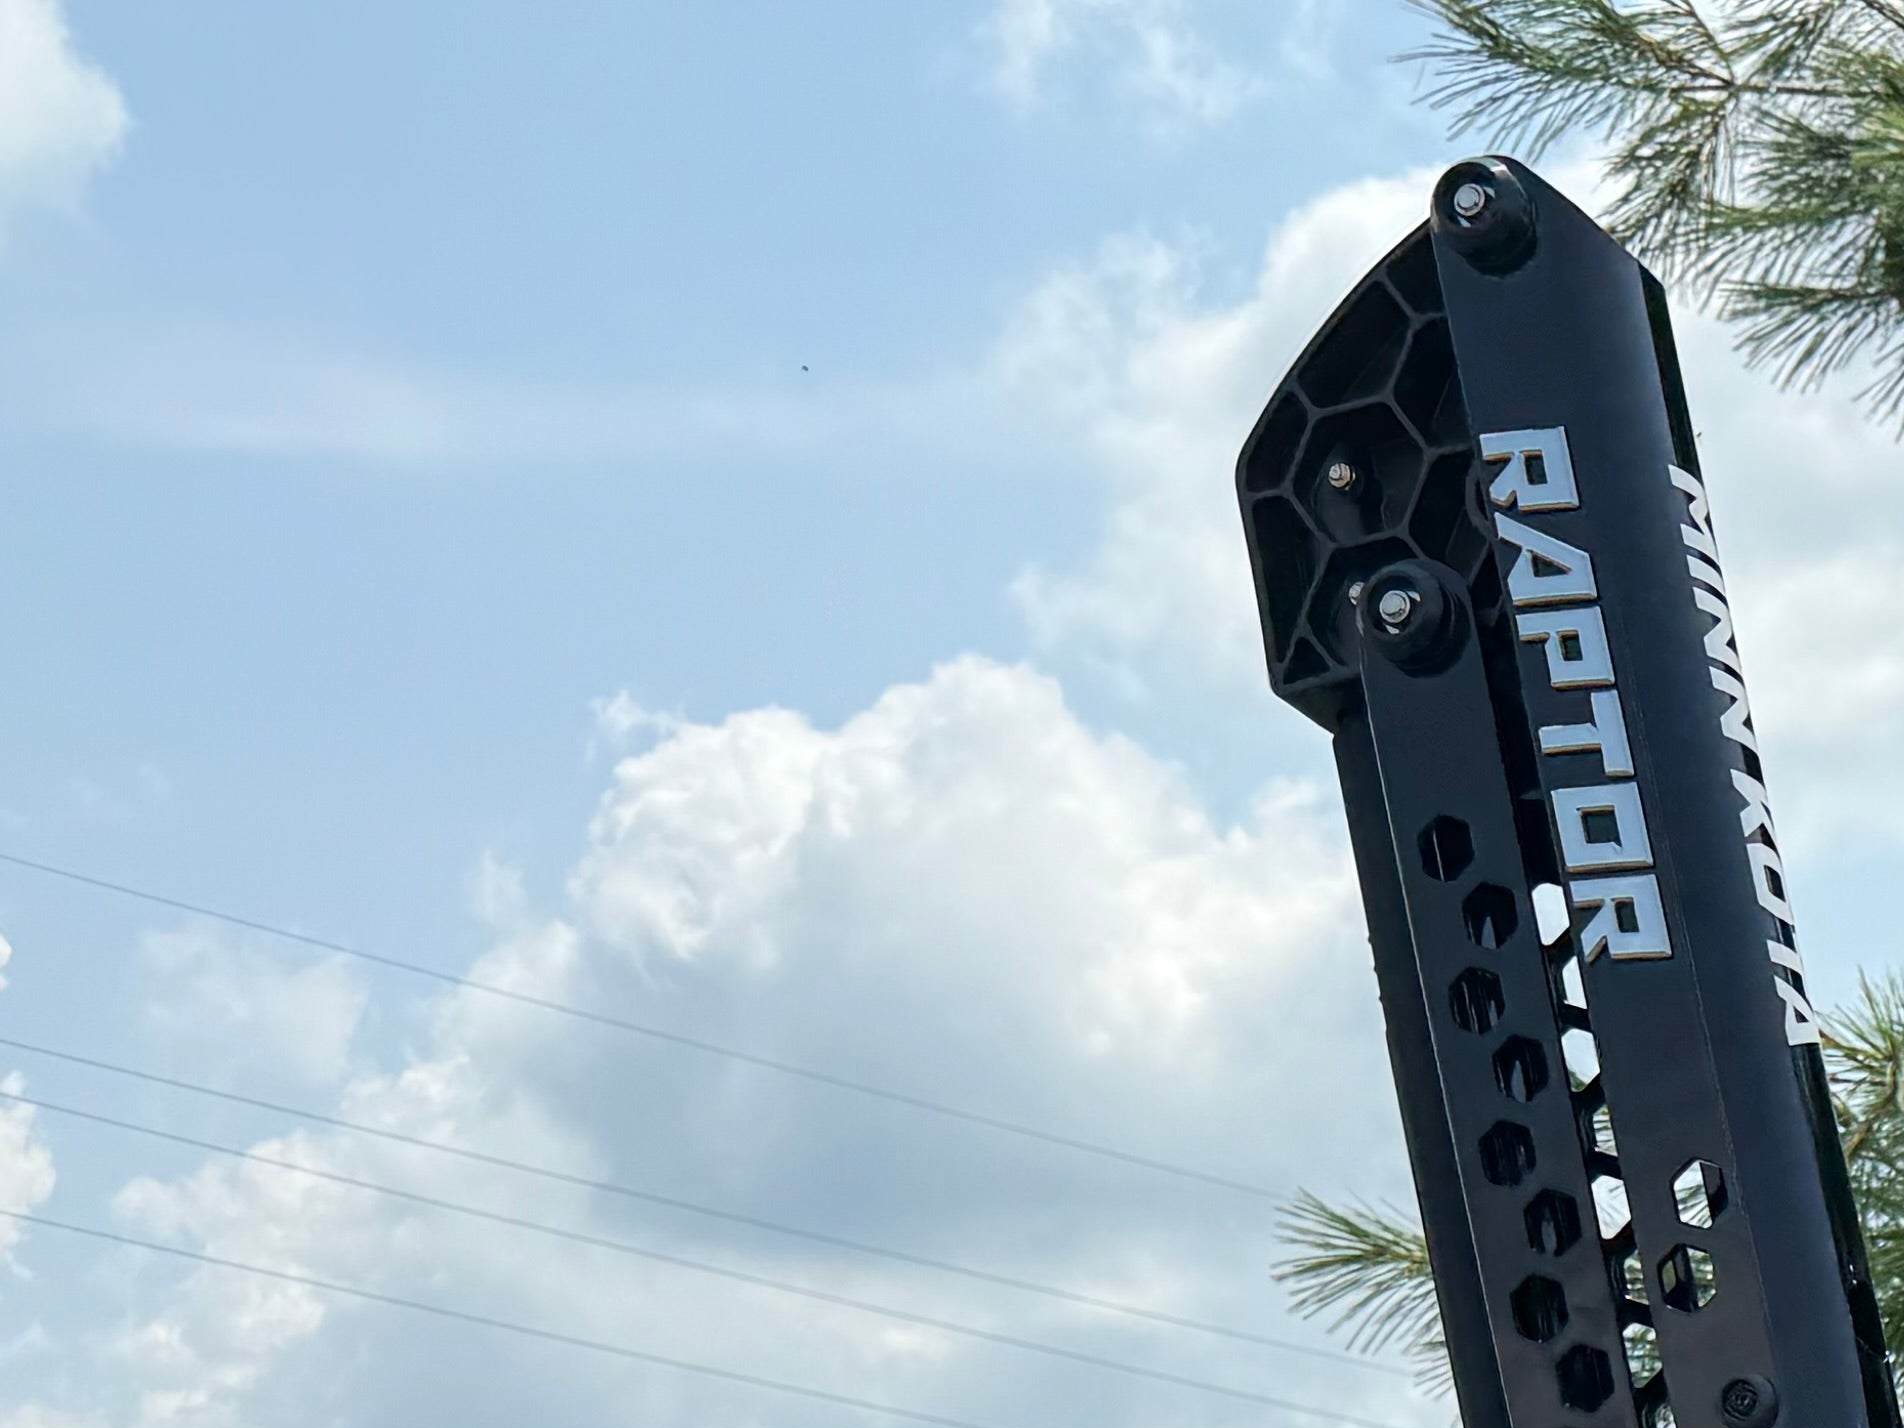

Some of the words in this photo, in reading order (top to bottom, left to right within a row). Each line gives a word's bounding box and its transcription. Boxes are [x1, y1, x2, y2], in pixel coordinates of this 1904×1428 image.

[1480, 426, 1673, 960] RAPTOR
[1668, 463, 1760, 758] MINN
[1730, 768, 1820, 1047] KOTA
